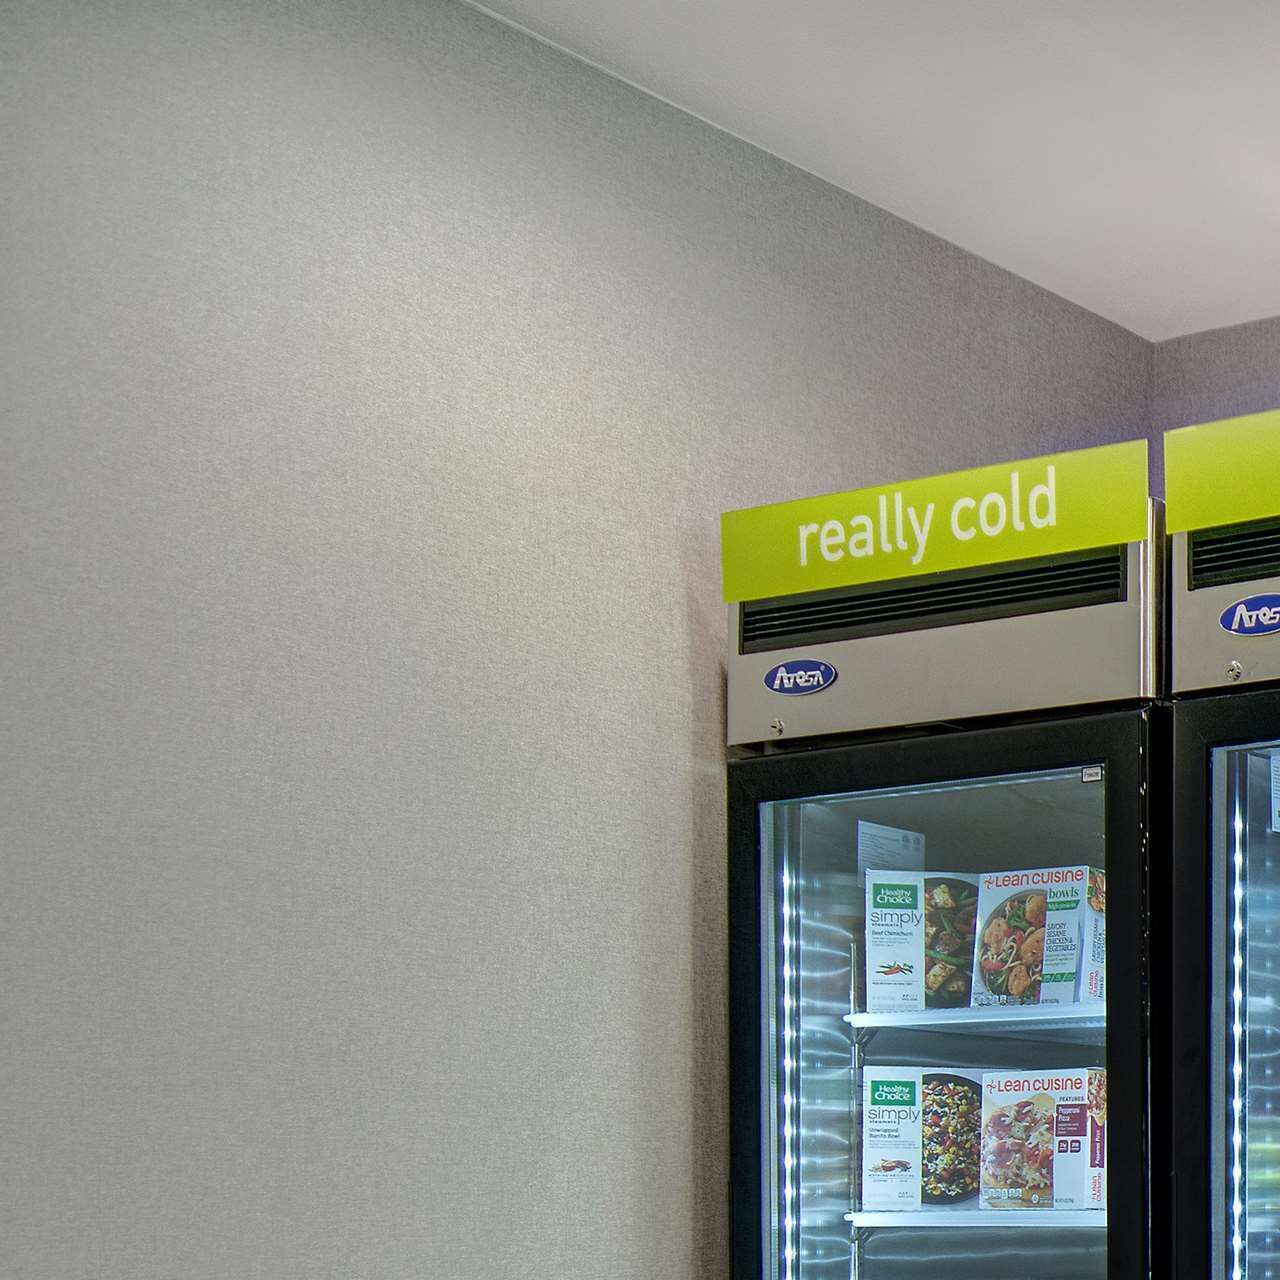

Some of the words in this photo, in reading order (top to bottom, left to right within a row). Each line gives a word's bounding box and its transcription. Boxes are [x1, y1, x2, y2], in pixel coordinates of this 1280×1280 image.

[799, 493, 934, 566] really
[951, 465, 1057, 541] cold
[995, 873, 1029, 888] Lean
[876, 895, 912, 904] Choice
[1048, 887, 1080, 899] bowls
[870, 910, 922, 928] simply
[998, 1079, 1030, 1092] Lean
[875, 1091, 910, 1101] Choice
[868, 1107, 920, 1125] simply
